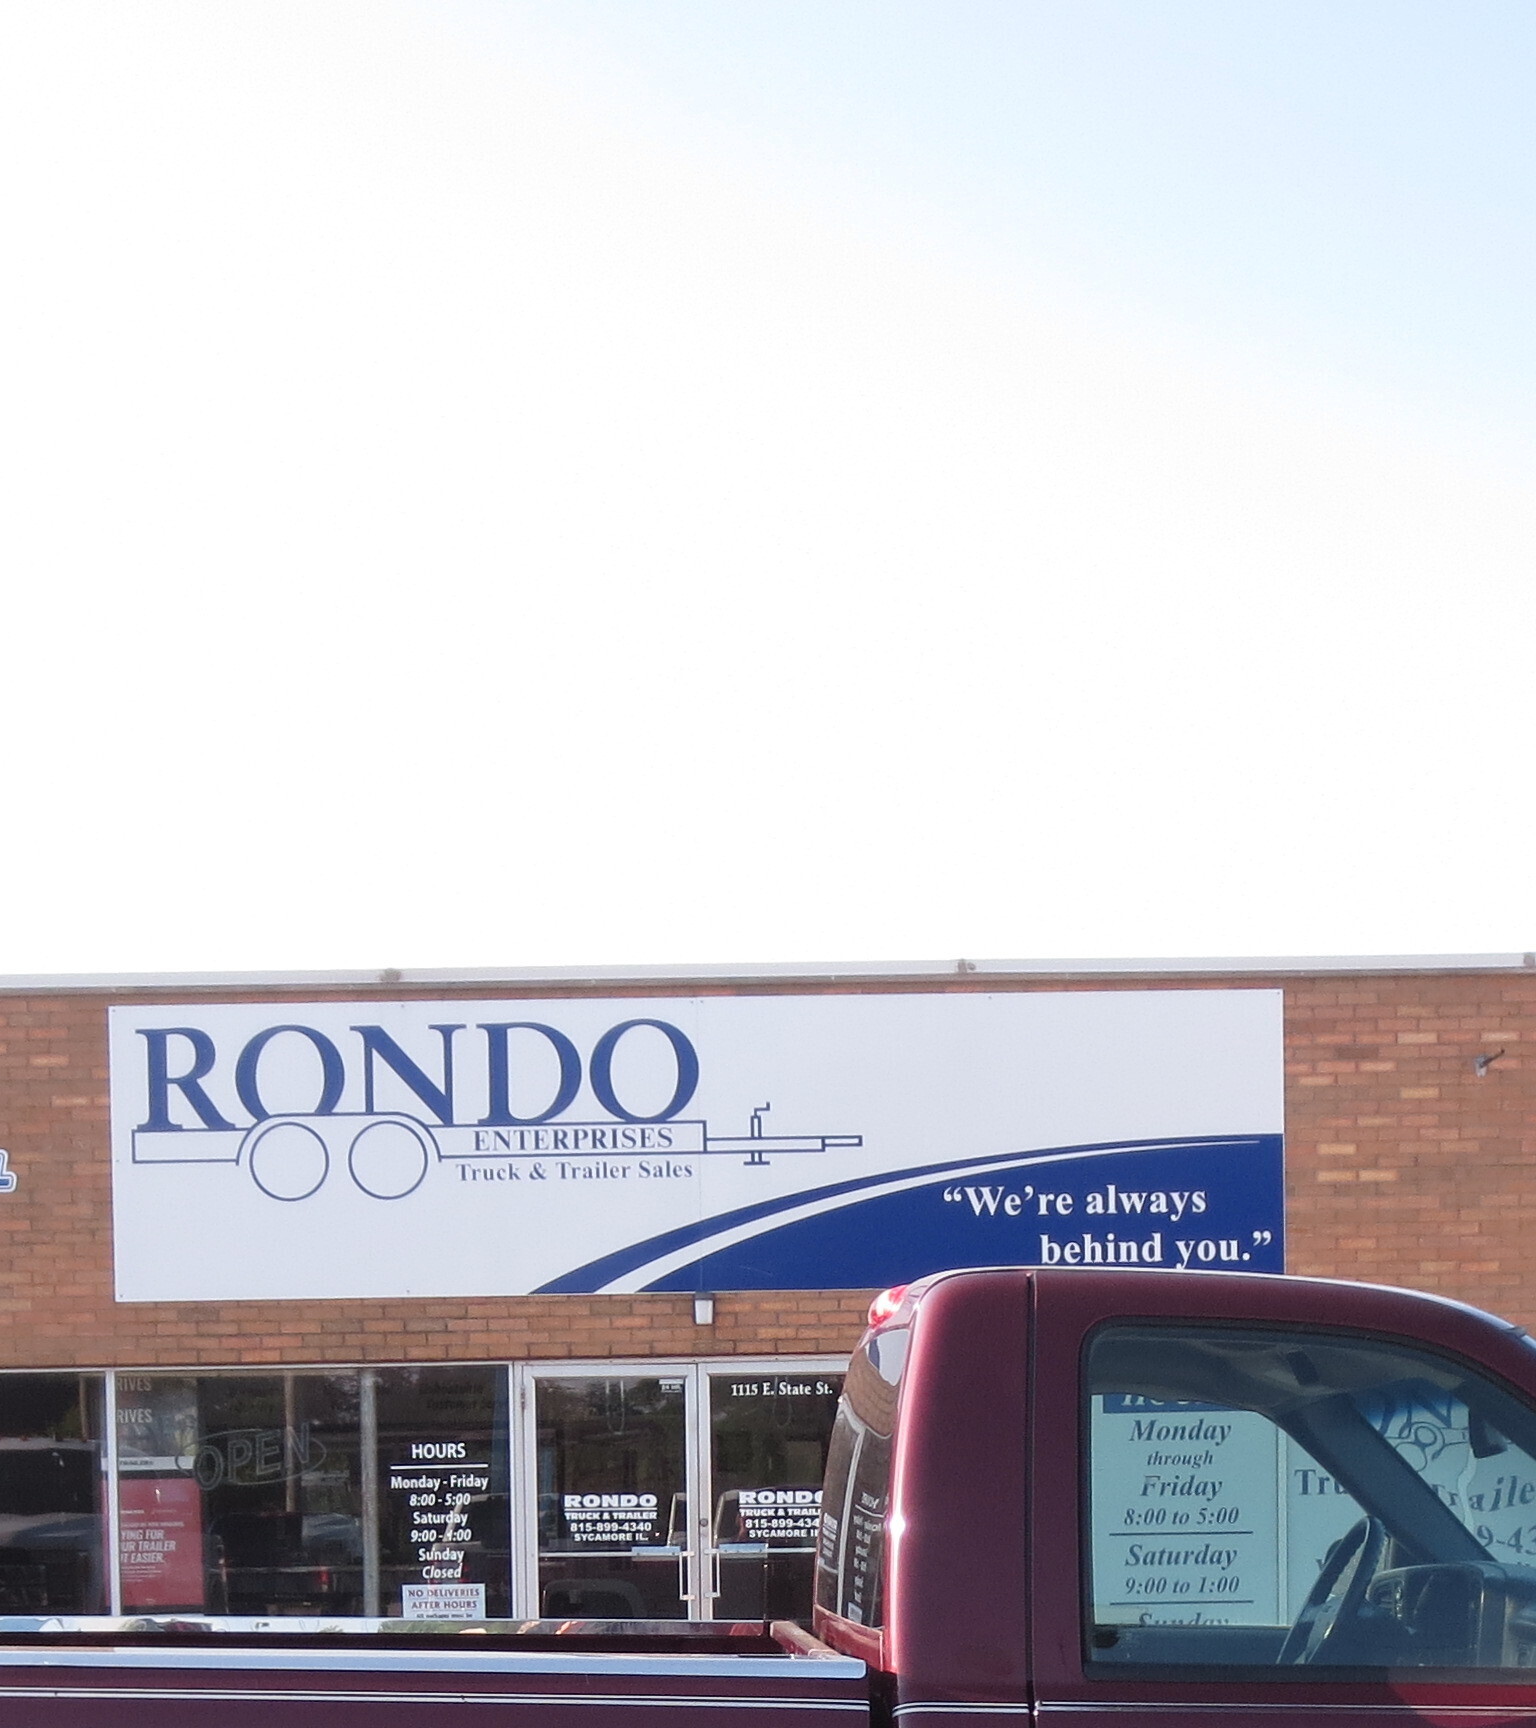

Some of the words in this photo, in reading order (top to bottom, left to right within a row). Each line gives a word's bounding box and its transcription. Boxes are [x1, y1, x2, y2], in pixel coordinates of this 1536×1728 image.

[135, 1018, 700, 1132] RONDO
[472, 1126, 674, 1152] ENTERPRISES
[455, 1161, 521, 1183] Truck
[527, 1161, 548, 1182] &
[555, 1159, 632, 1181] Trailer
[638, 1159, 694, 1180] Sales
[942, 1185, 1074, 1217] “We’re
[1085, 1184, 1207, 1222] always
[1039, 1232, 1164, 1265] behind
[730, 1382, 759, 1397] 1115
[762, 1382, 775, 1396] E.
[778, 1381, 812, 1396] State
[815, 1381, 834, 1395] St.
[116, 1408, 153, 1424] RIVES
[1128, 1418, 1232, 1447] Monday
[193, 1422, 310, 1491] OPEN
[411, 1442, 466, 1460] HOURS
[1146, 1450, 1214, 1469] through
[390, 1475, 441, 1491] Monday
[450, 1473, 489, 1491] Friday
[1140, 1475, 1224, 1501] Friday
[409, 1493, 436, 1507] 8:00
[444, 1492, 471, 1506] 5:00
[564, 1493, 658, 1508] RONDO
[413, 1511, 469, 1527] Saturday
[564, 1511, 601, 1521] TRUCK
[613, 1510, 658, 1520] TRAILER
[739, 1507, 775, 1517] TRUCK
[1124, 1507, 1167, 1527] 8:00
[1172, 1507, 1191, 1526] to
[1196, 1506, 1240, 1526] 5:00
[570, 1521, 652, 1532] 815-899-4340
[745, 1517, 820, 1529] 815-899-434
[410, 1529, 438, 1543] 9:00
[573, 1532, 633, 1542] SYCAMORE
[748, 1528, 808, 1538] SYCAMORE
[418, 1547, 465, 1563] Sunday
[1125, 1543, 1238, 1571] Saturday
[421, 1562, 463, 1579] Closed
[407, 1589, 424, 1598] NO
[427, 1588, 481, 1598] DELIVERIES
[1124, 1576, 1167, 1595] 9:00
[1173, 1577, 1191, 1594] to
[1198, 1575, 1240, 1594] 1:00
[411, 1601, 440, 1610] AFTER
[444, 1600, 478, 1610] HOURS
